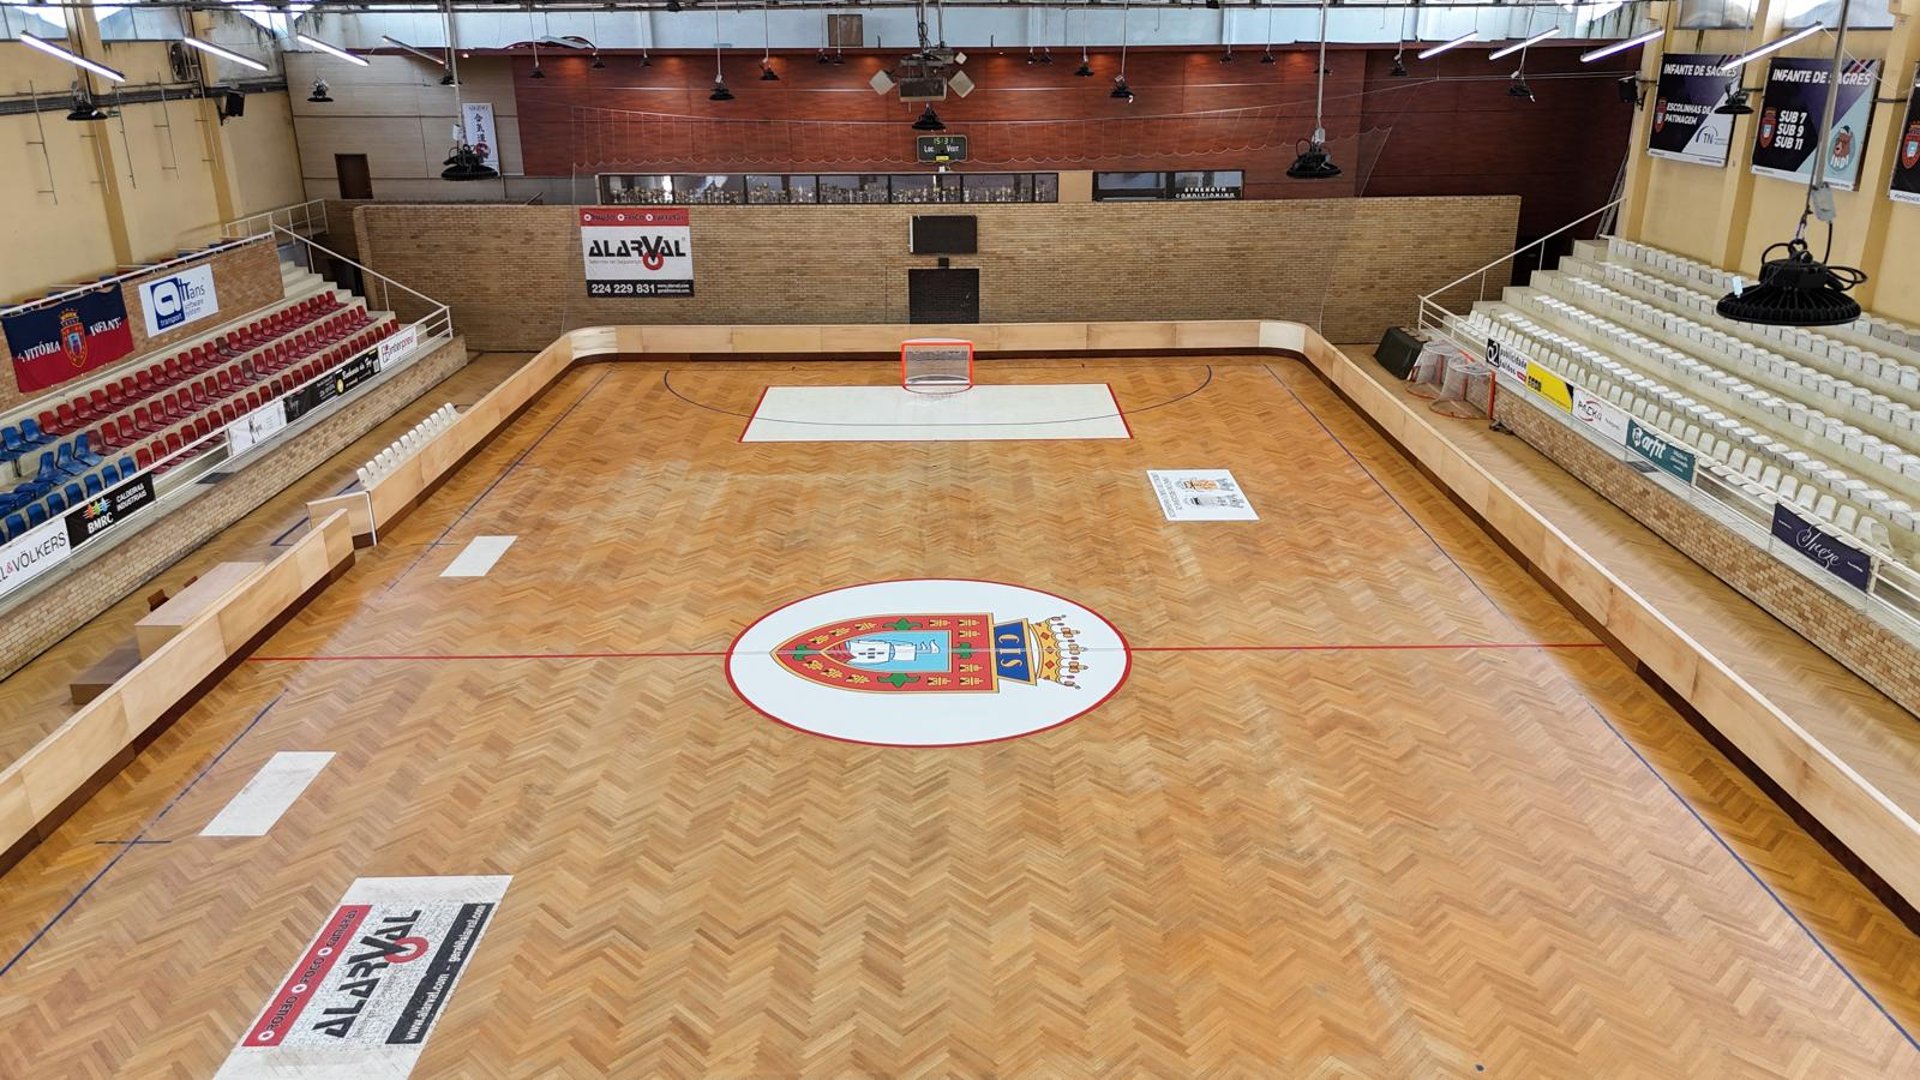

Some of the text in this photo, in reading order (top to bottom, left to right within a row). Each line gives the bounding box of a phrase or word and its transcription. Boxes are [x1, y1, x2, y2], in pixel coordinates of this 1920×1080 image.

[1663, 64, 1692, 75] INFANTE
[1694, 65, 1705, 76] DE
[1772, 69, 1872, 86] INFANTE DE AGRES
[1667, 103, 1701, 114] ESCOLINHAS
[1778, 110, 1807, 124] SUB 7
[1665, 114, 1698, 125] PATINAGEM
[1776, 123, 1805, 138] SUB 9
[1774, 136, 1804, 151] SUB 11
[588, 235, 686, 263] ALARVAL
[591, 283, 656, 293] 224 229 831
[24, 341, 61, 361] VITÓRIA
[116, 483, 145, 503] CALDEIRAS
[116, 490, 147, 511] INDUSTRIAIS
[87, 512, 114, 534] BMRC
[0, 531, 67, 582] L&VÖLKERS
[998, 634, 1023, 668] CIS
[312, 910, 423, 1038] ALARVAL
[404, 973, 450, 1040] www.alarval.com
